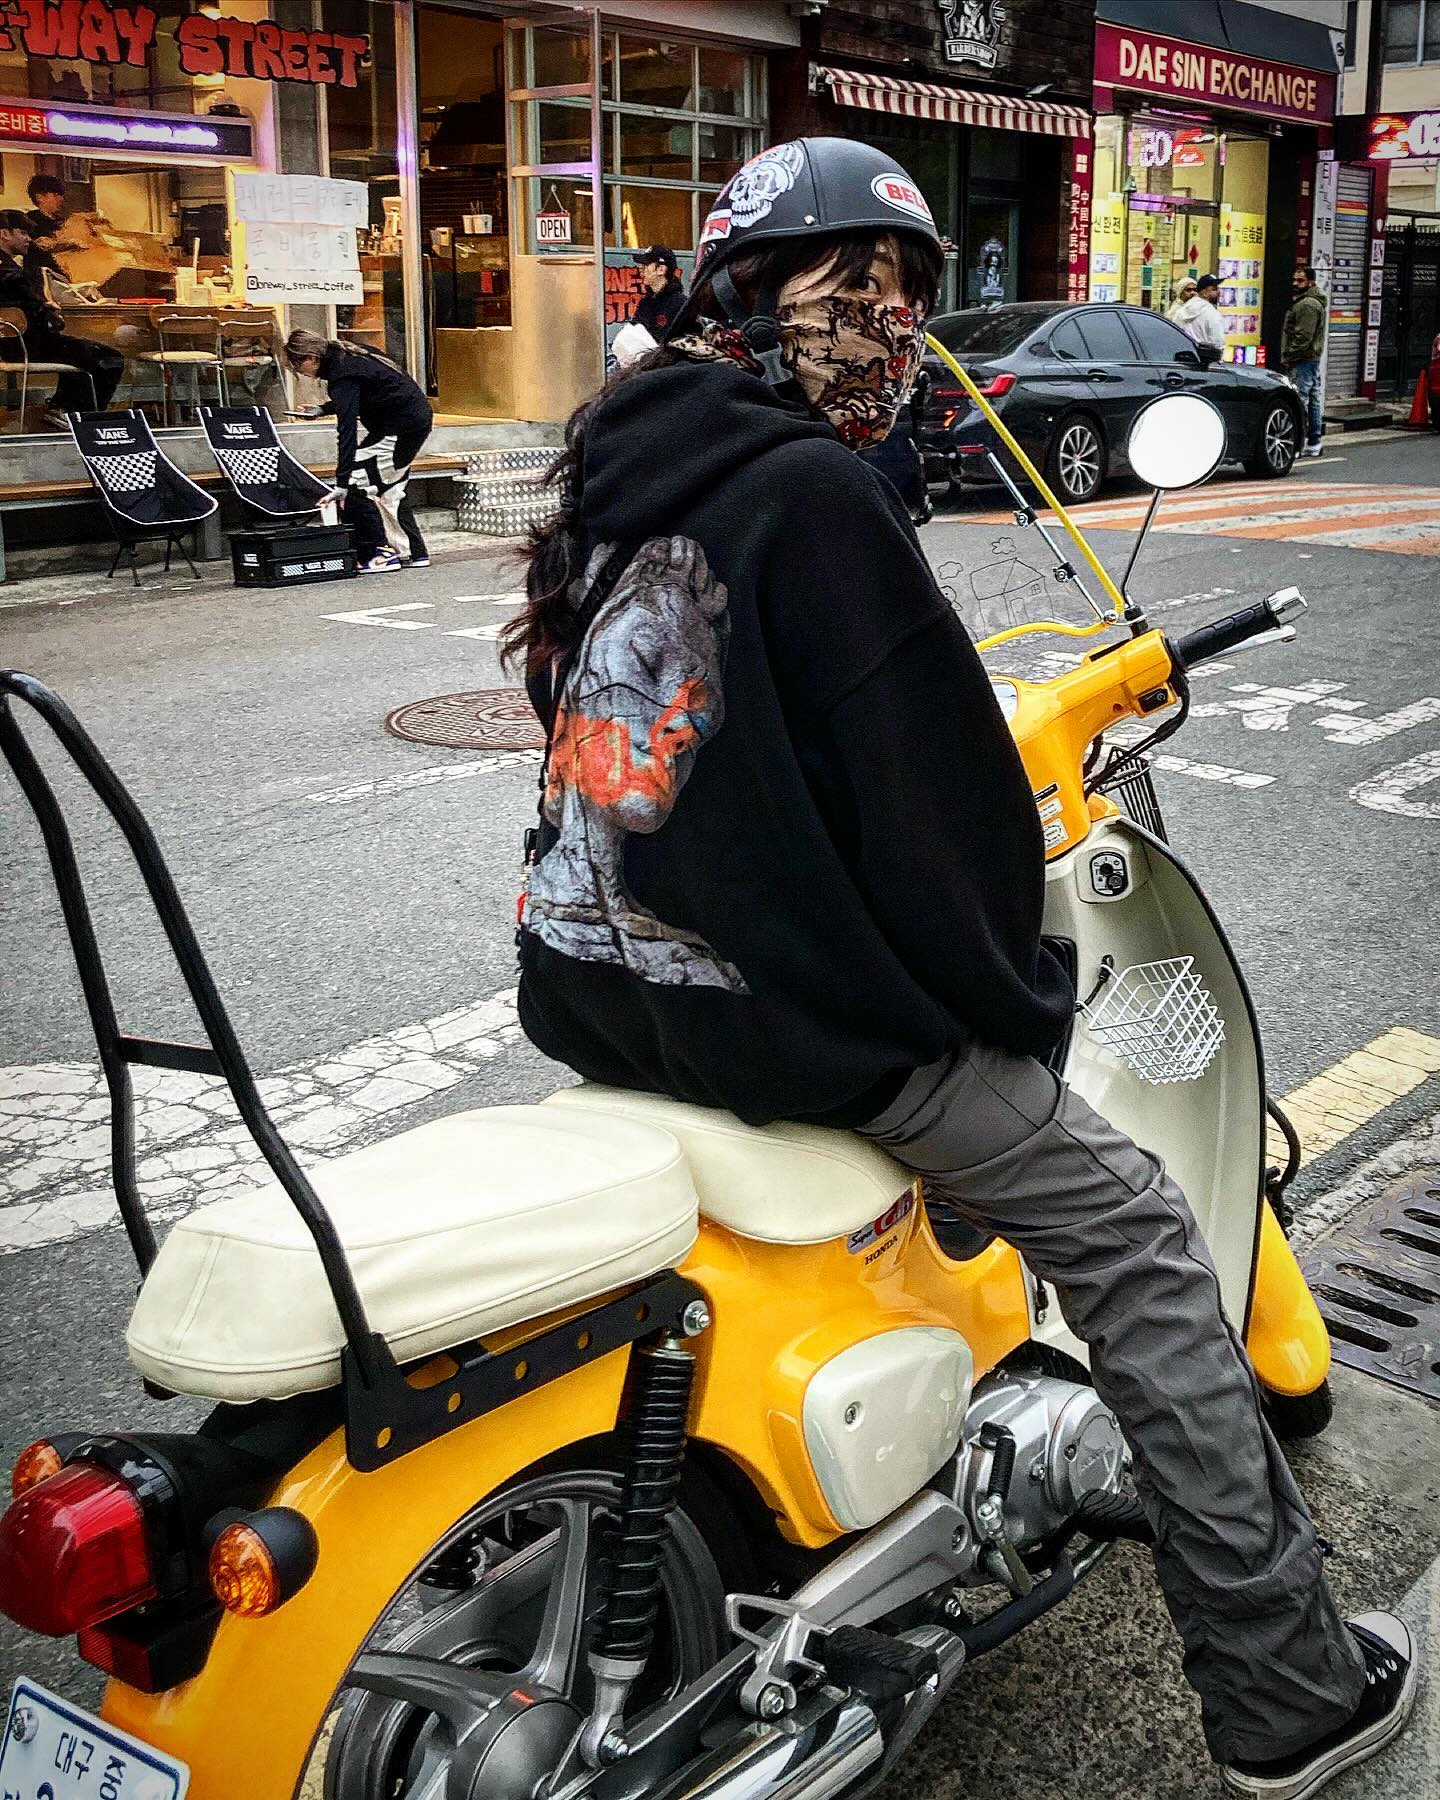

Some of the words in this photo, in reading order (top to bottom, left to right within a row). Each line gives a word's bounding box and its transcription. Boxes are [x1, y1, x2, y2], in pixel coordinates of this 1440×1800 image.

[175, 13, 370, 88] STREET
[1119, 38, 1168, 84] DAE
[1171, 50, 1205, 92] SIN
[1210, 58, 1317, 112] EXCHANGE
[540, 218, 567, 238] OPEN
[95, 427, 129, 440] VANS
[222, 422, 254, 434] VANS
[864, 1235, 899, 1266] HONDA
[54, 1731, 96, 1781] 대구
